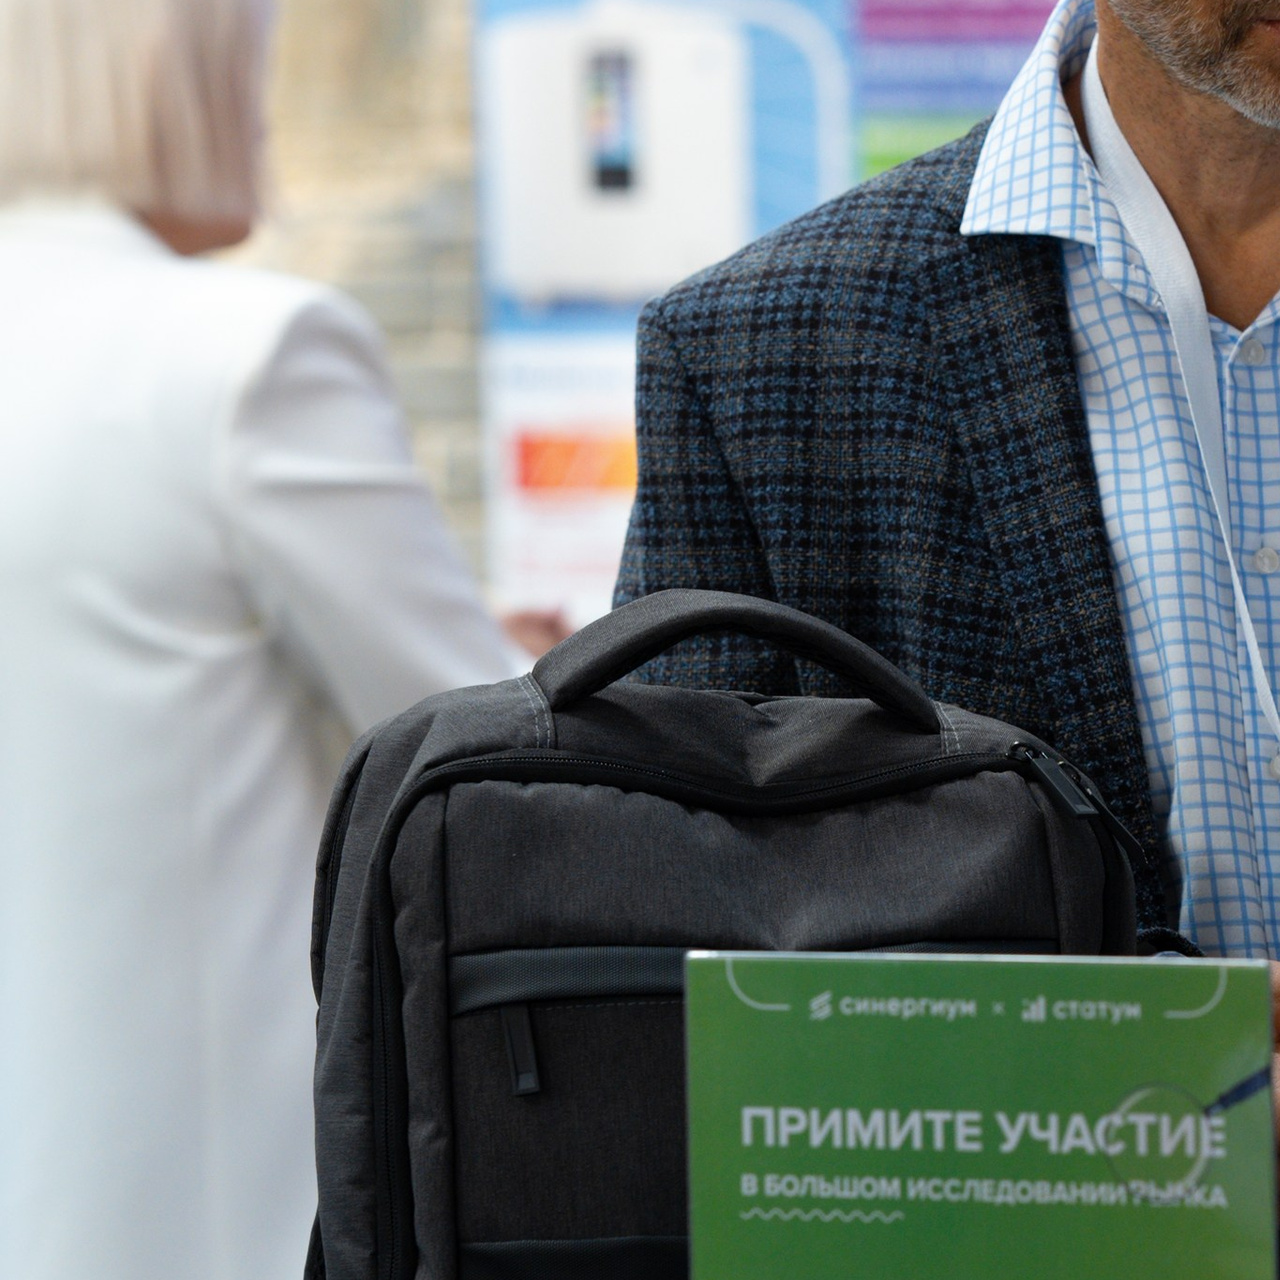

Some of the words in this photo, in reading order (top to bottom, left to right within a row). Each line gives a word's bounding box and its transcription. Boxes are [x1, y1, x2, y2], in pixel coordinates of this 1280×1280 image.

[839, 995, 977, 1021] синергиум
[741, 1105, 984, 1152] ПРИМИТЕ
[995, 1111, 1228, 1158] УЧАСТИЕ
[740, 1173, 759, 1197] В
[763, 1174, 902, 1200] БОЛЬШОМ
[906, 1177, 1128, 1206] ИССЛЕДОВАНИИ
[1128, 1180, 1229, 1209] РЫНКА
